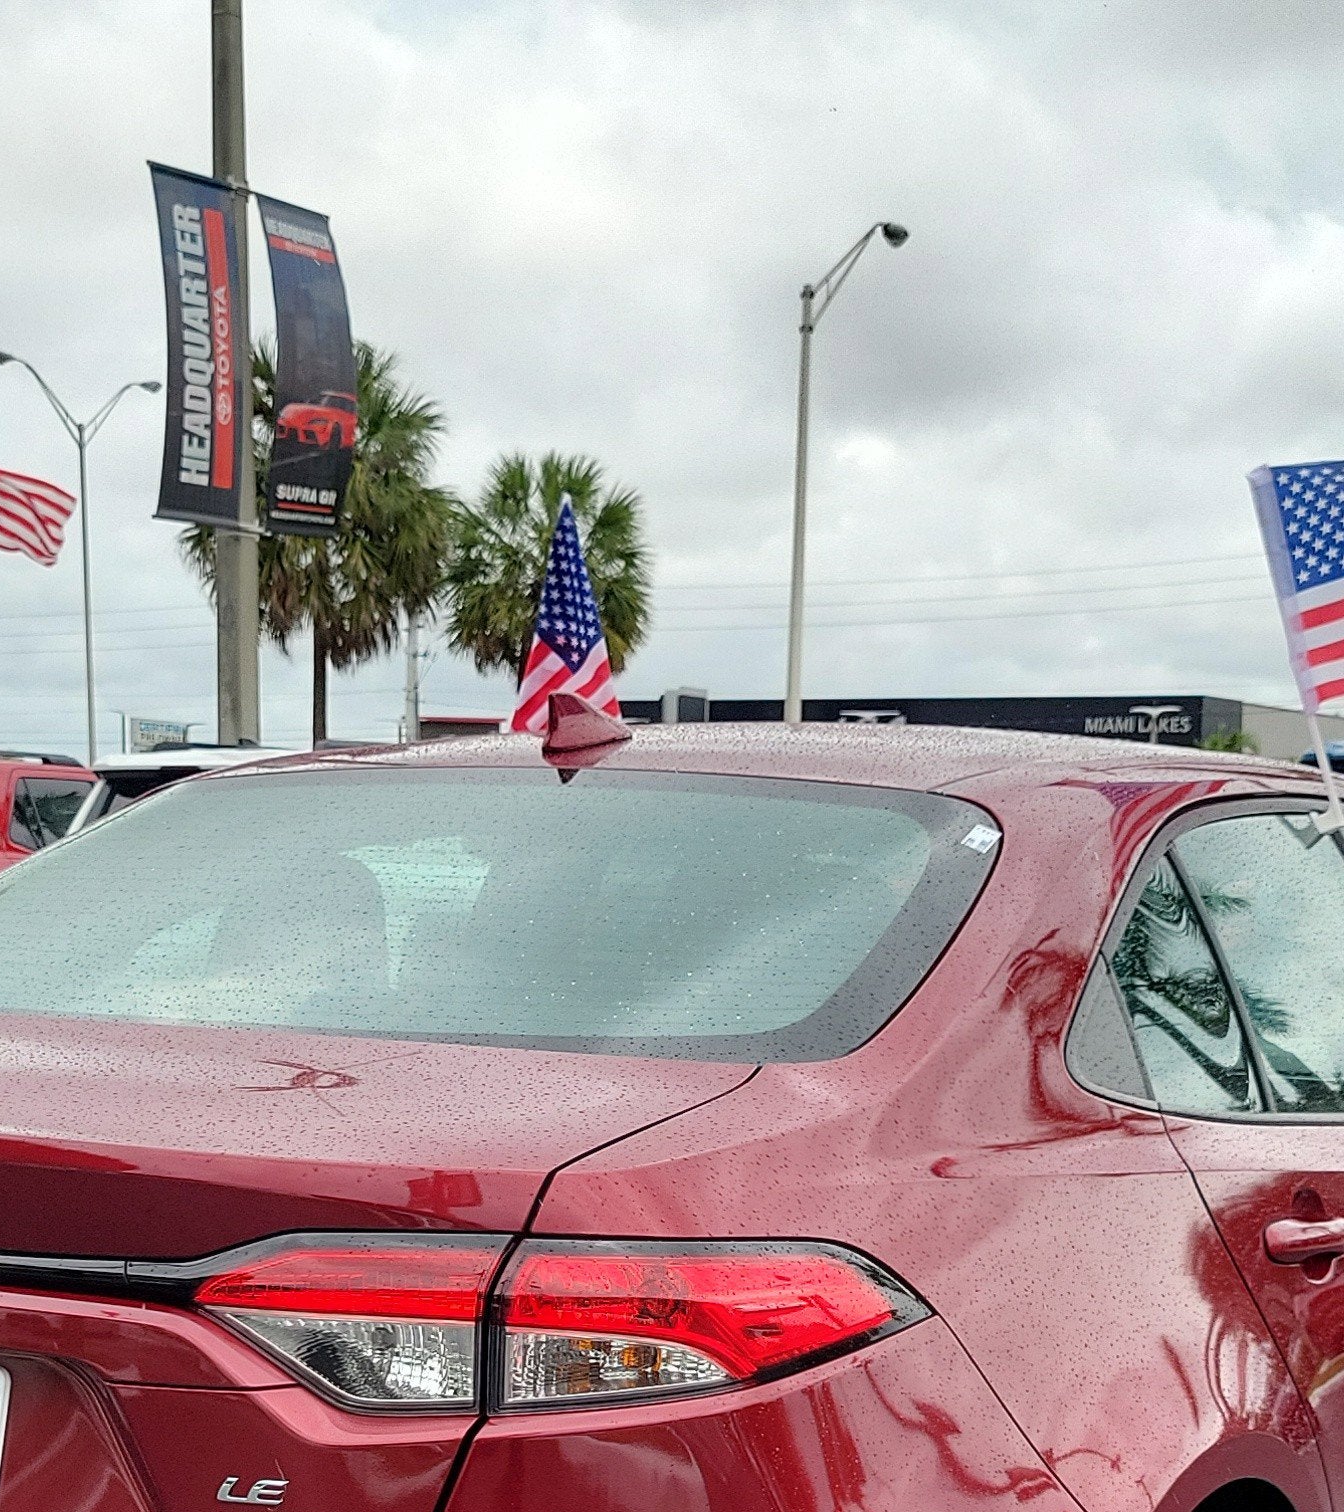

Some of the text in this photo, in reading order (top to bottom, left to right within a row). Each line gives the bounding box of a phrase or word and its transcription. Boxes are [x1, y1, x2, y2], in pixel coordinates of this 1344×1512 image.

[172, 204, 215, 487] HEADQUARTER
[213, 286, 232, 388] TOYOTA
[1084, 716, 1135, 733] MIAMI
[216, 1476, 289, 1505] LE
